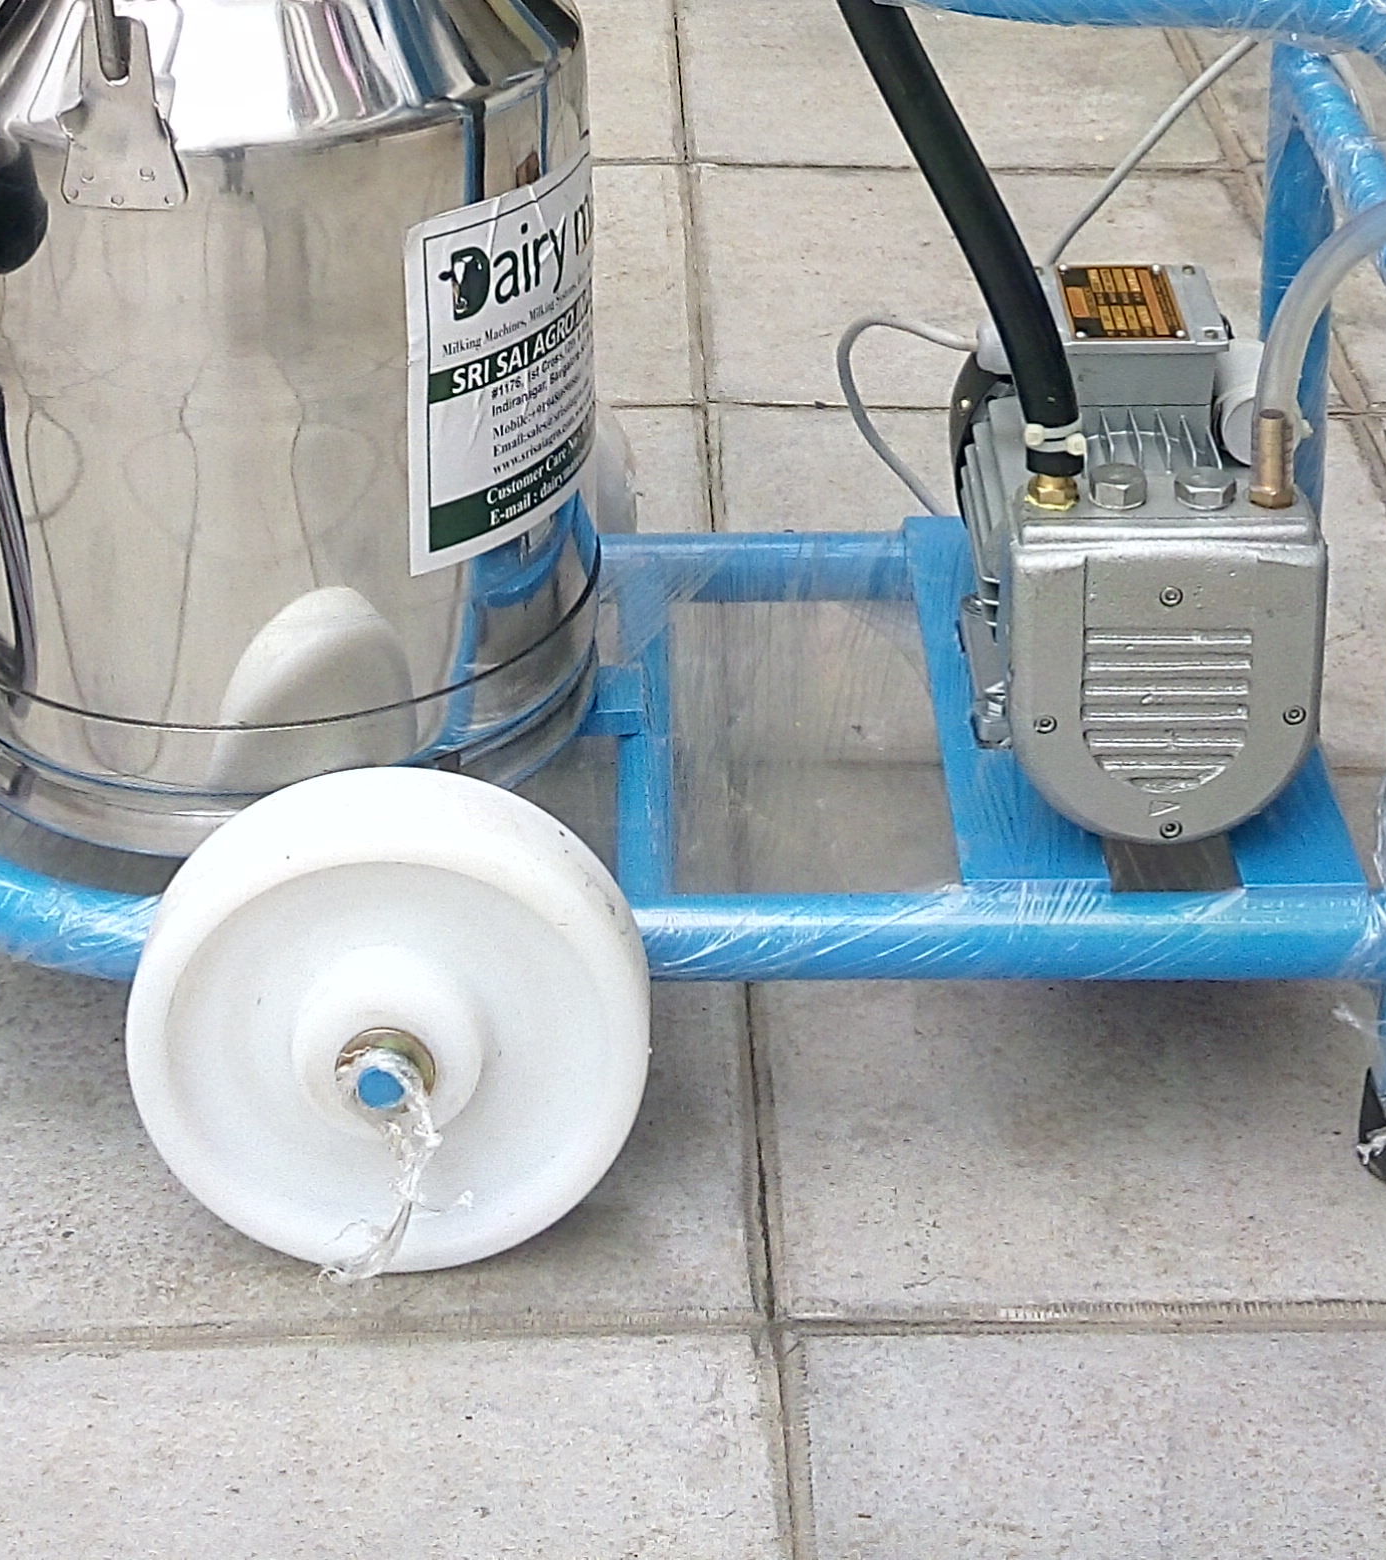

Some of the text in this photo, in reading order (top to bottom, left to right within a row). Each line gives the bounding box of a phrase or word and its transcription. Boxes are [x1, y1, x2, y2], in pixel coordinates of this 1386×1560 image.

[438, 213, 567, 321] Dairy
[442, 337, 482, 358] Milking
[451, 308, 575, 395] SRI SAI AGRO
[486, 463, 544, 505] Customer
[489, 491, 531, 527] E-mail
